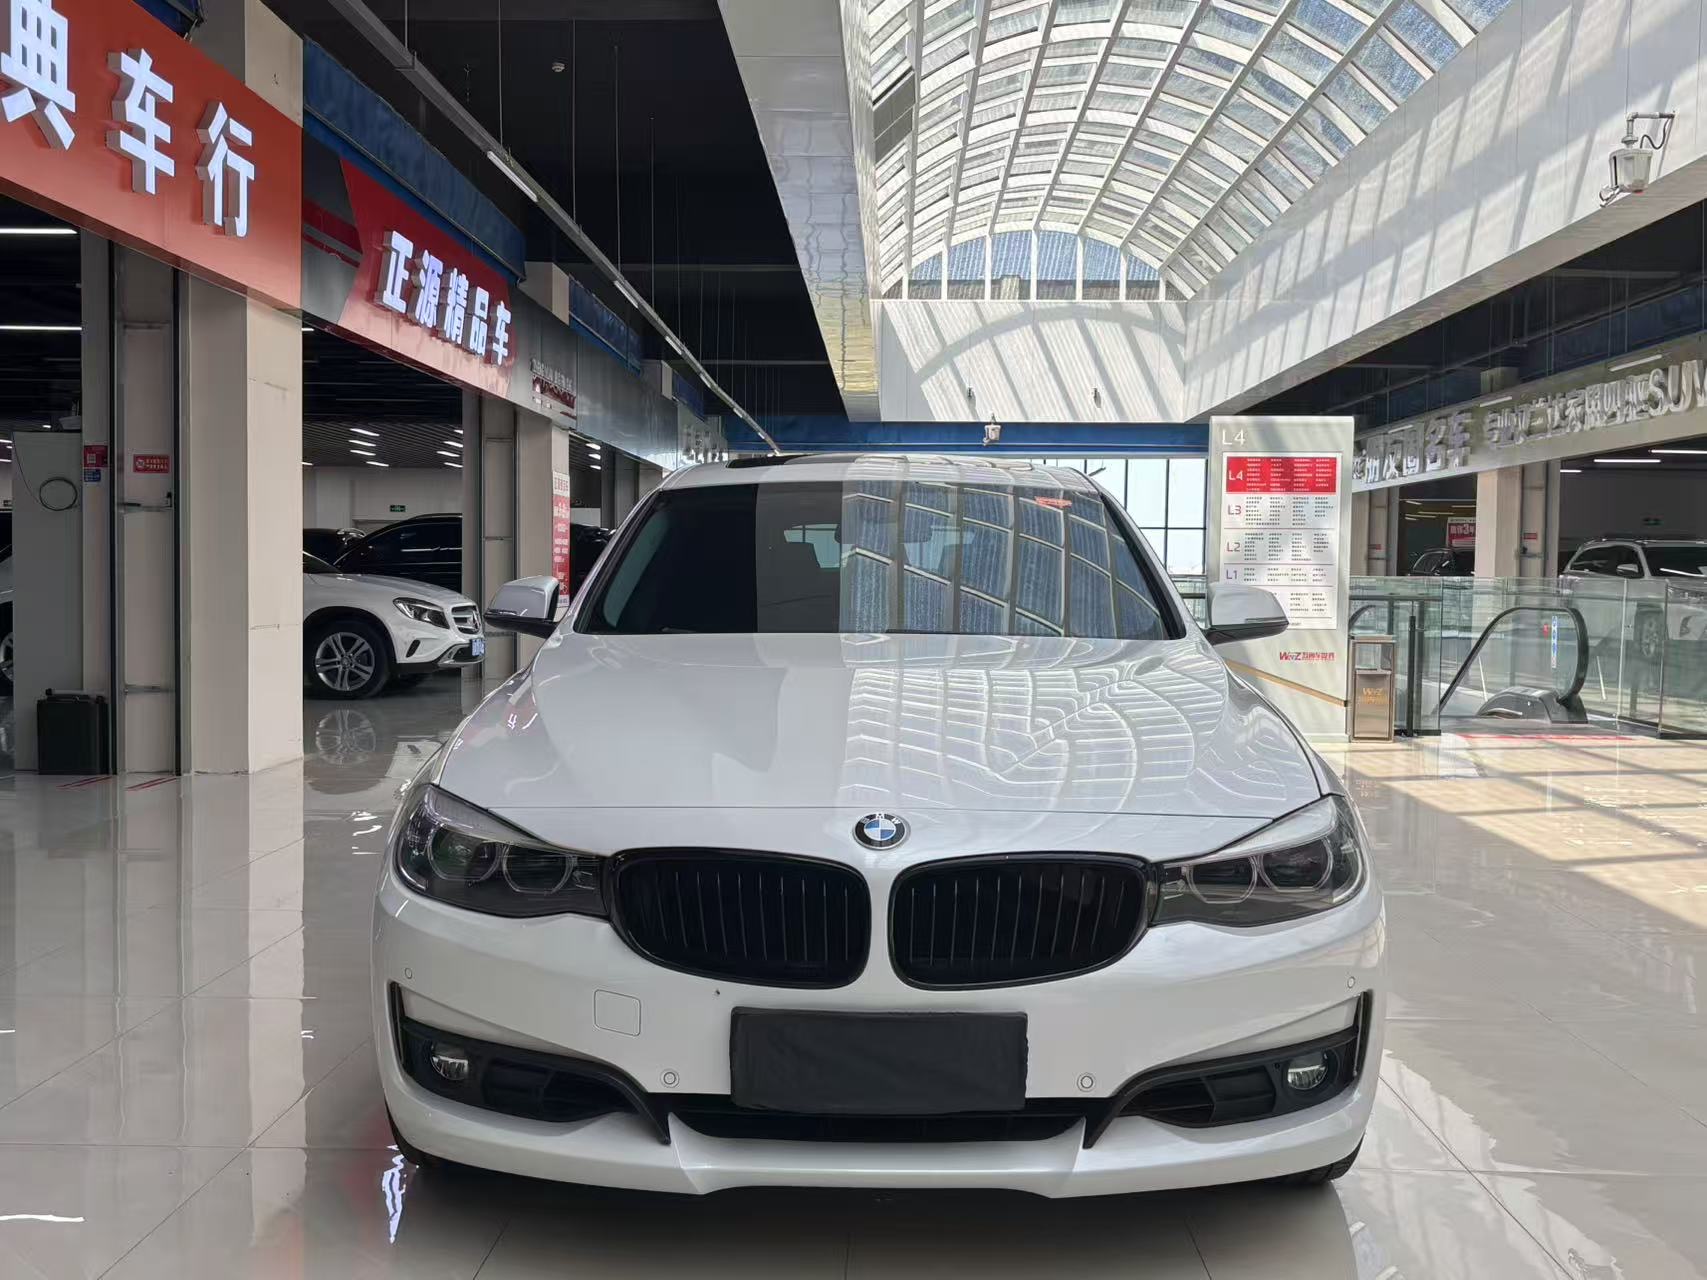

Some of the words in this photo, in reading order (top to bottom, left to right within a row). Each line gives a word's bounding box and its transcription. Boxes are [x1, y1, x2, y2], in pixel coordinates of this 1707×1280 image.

[0, 0, 255, 238] 典车行
[382, 230, 512, 366] 正源精品车
[1222, 428, 1246, 446] L4
[1228, 470, 1244, 481] L4
[1227, 504, 1242, 516] L3
[1226, 541, 1241, 553] L2
[1225, 569, 1238, 580] L1
